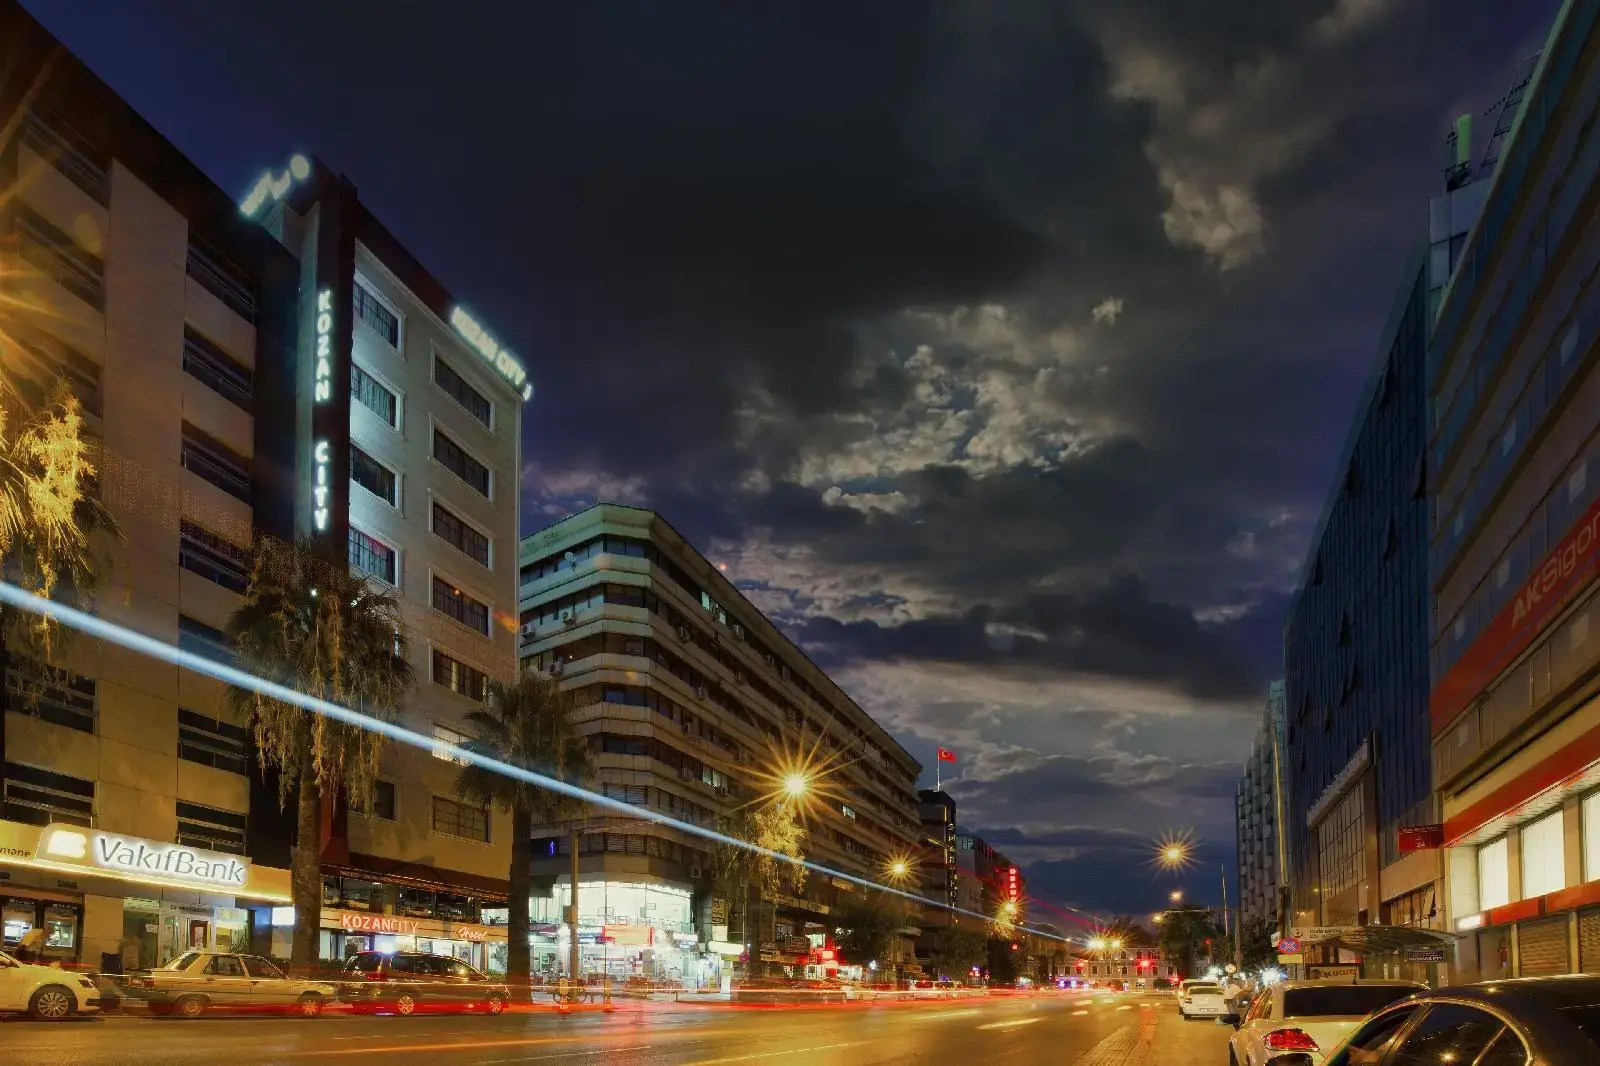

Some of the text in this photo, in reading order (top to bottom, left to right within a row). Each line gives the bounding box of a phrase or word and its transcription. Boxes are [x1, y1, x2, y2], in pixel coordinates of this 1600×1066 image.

[313, 290, 331, 531] KOZAN CITY
[98, 836, 245, 883] VakıfBank
[458, 926, 488, 940] Hotel
